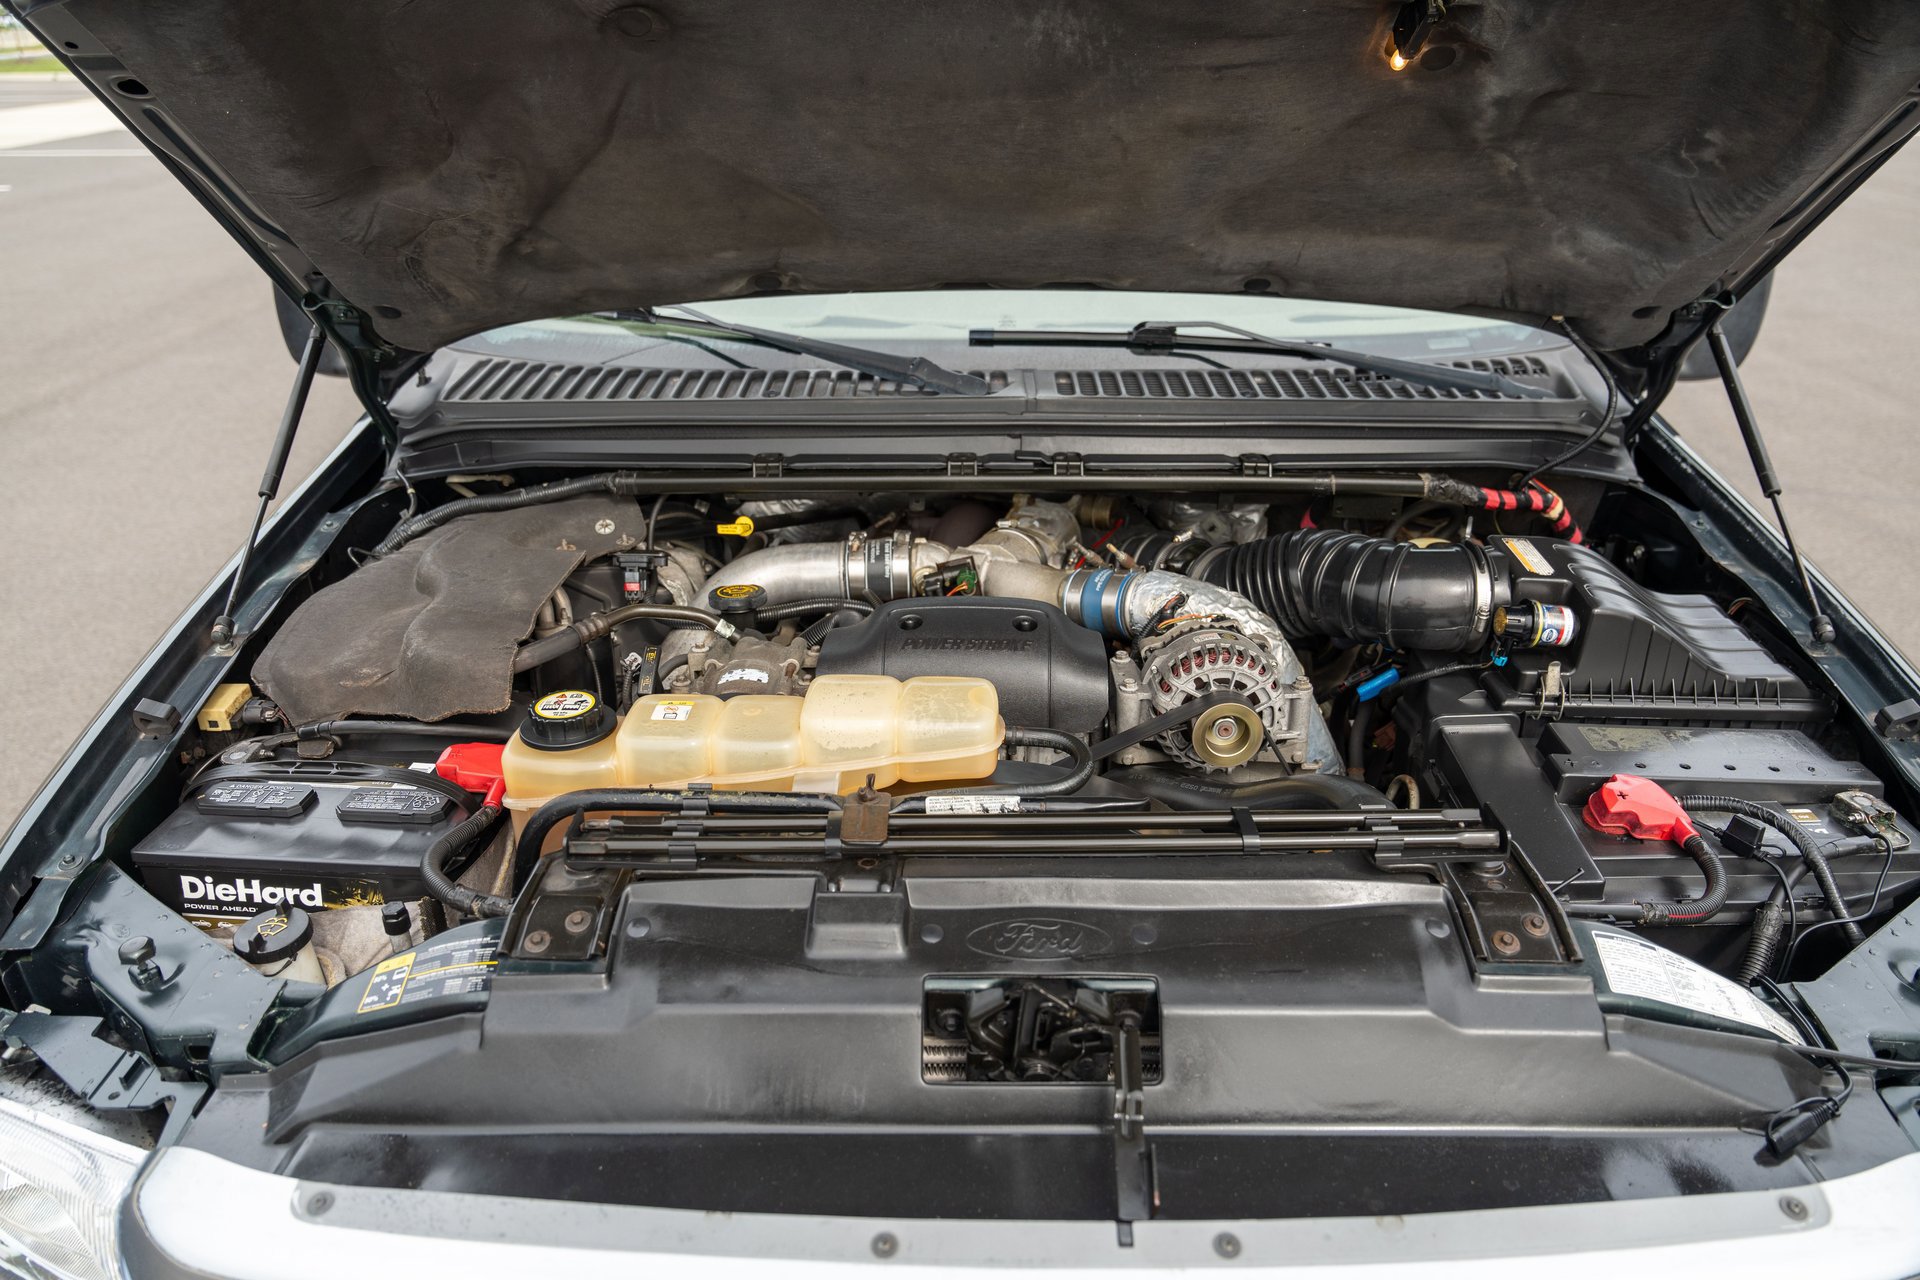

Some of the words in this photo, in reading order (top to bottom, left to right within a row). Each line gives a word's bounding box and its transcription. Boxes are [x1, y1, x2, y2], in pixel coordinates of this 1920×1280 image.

[902, 637, 963, 651] POWER
[180, 875, 324, 907] DieHard
[184, 903, 219, 911] POWER
[222, 905, 257, 913] AHEAD
[994, 922, 1084, 954] Ford
